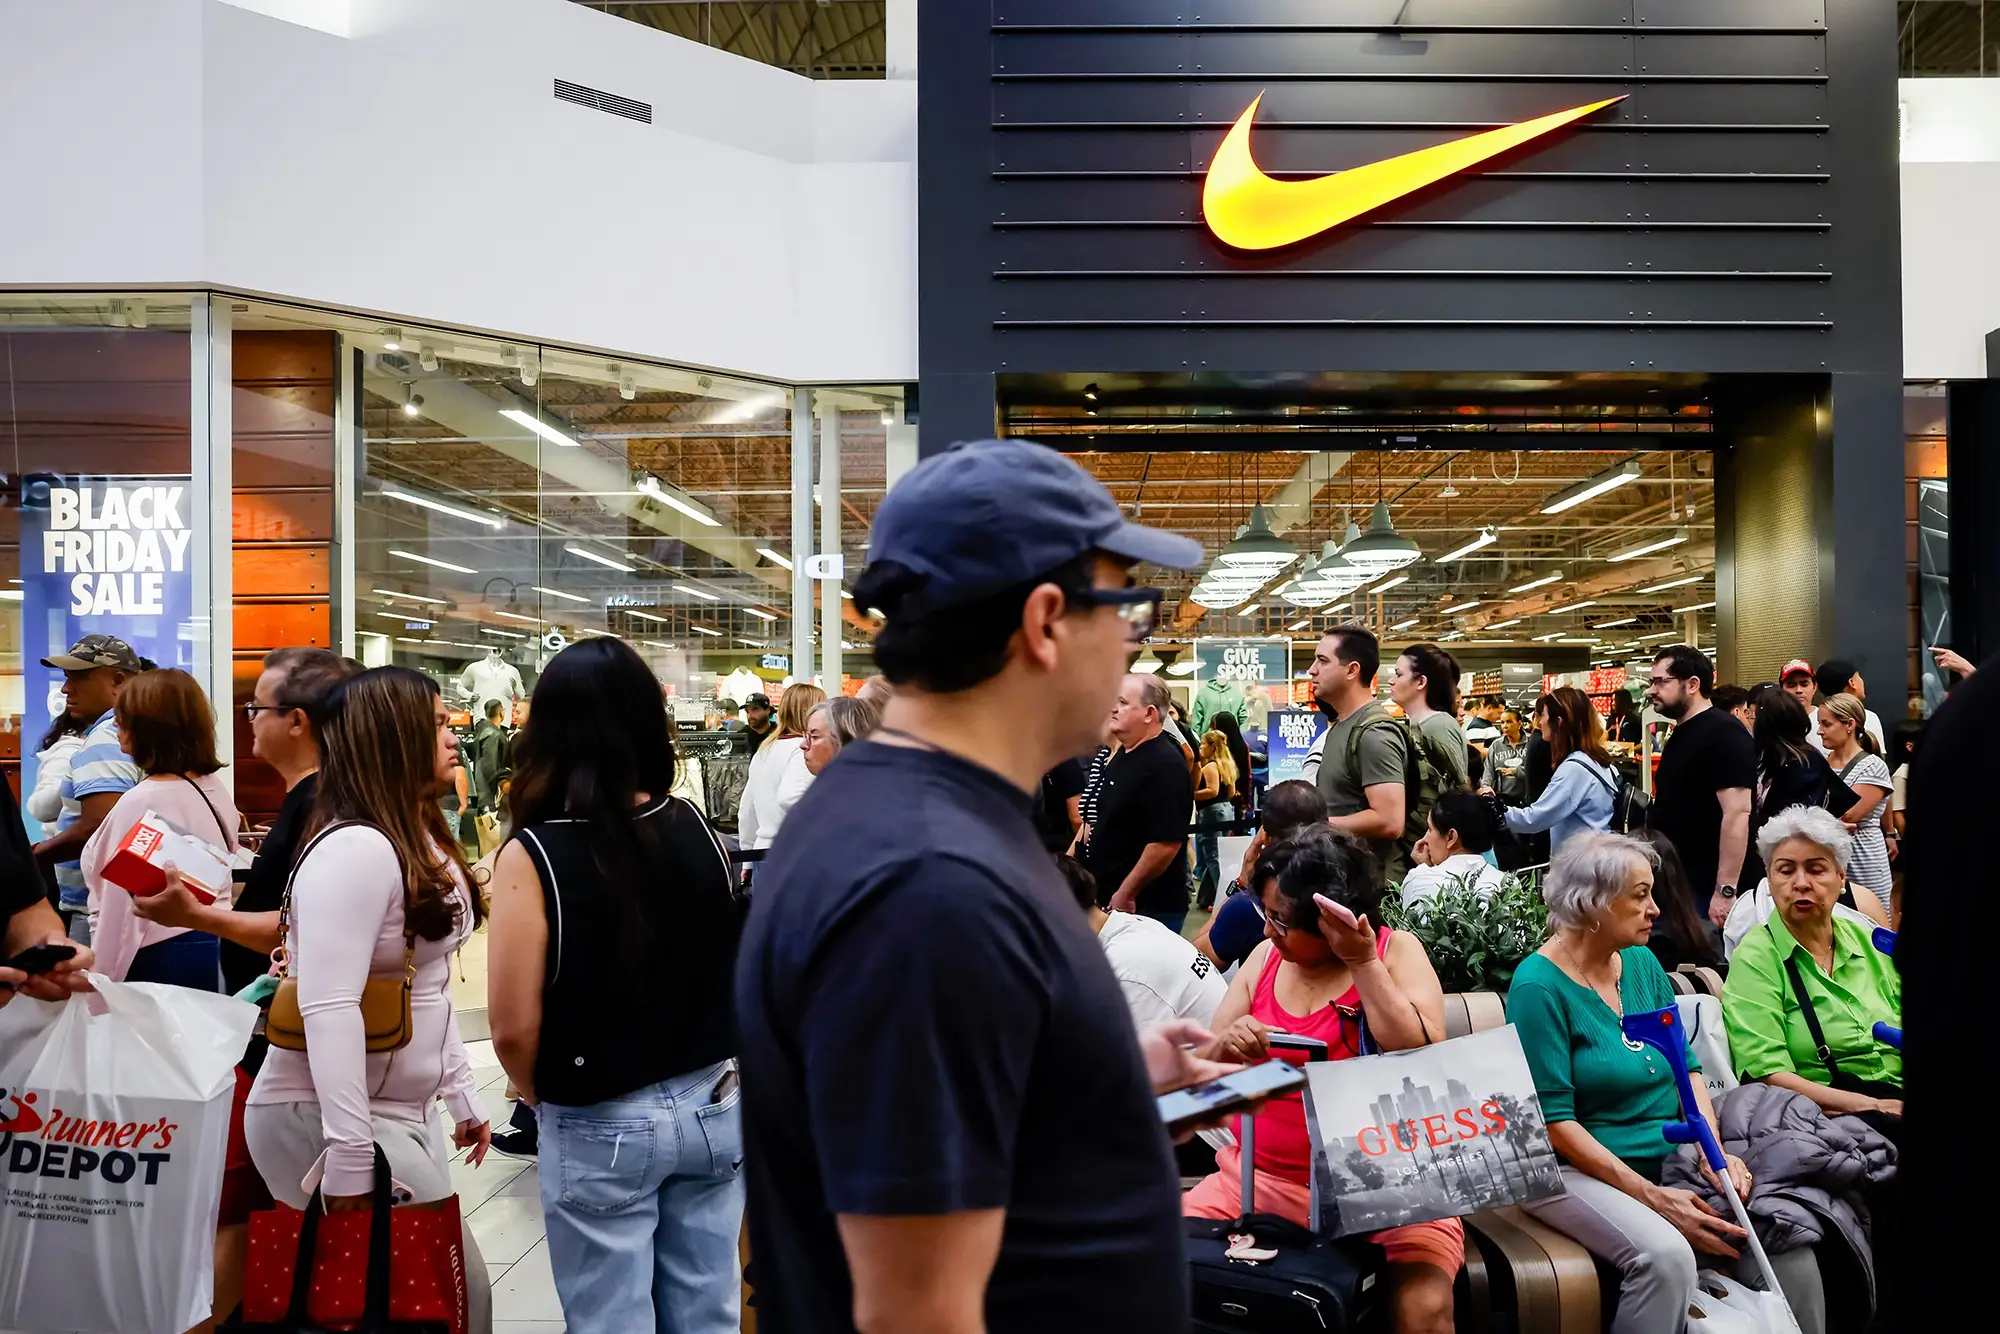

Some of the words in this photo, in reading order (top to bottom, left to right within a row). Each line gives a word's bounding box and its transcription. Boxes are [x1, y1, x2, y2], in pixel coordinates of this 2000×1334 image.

[50, 487, 184, 529] BLACK
[43, 530, 192, 572] FRIDAY
[71, 573, 163, 616] SALE
[1223, 648, 1259, 664] GIVE
[1217, 664, 1266, 680] SPORT
[1279, 726, 1317, 738] FRIDAY
[1280, 714, 1315, 726] BLACK
[1286, 737, 1310, 748] SALE
[127, 828, 158, 855] DIESEL
[1704, 1080, 1725, 1089] AN
[41, 1109, 178, 1149] Runner's
[1357, 1101, 1506, 1156] GUESS
[9, 1139, 171, 1185] DEPOT
[1396, 1164, 1420, 1177] LOS
[1427, 1152, 1484, 1171] ANGELES
